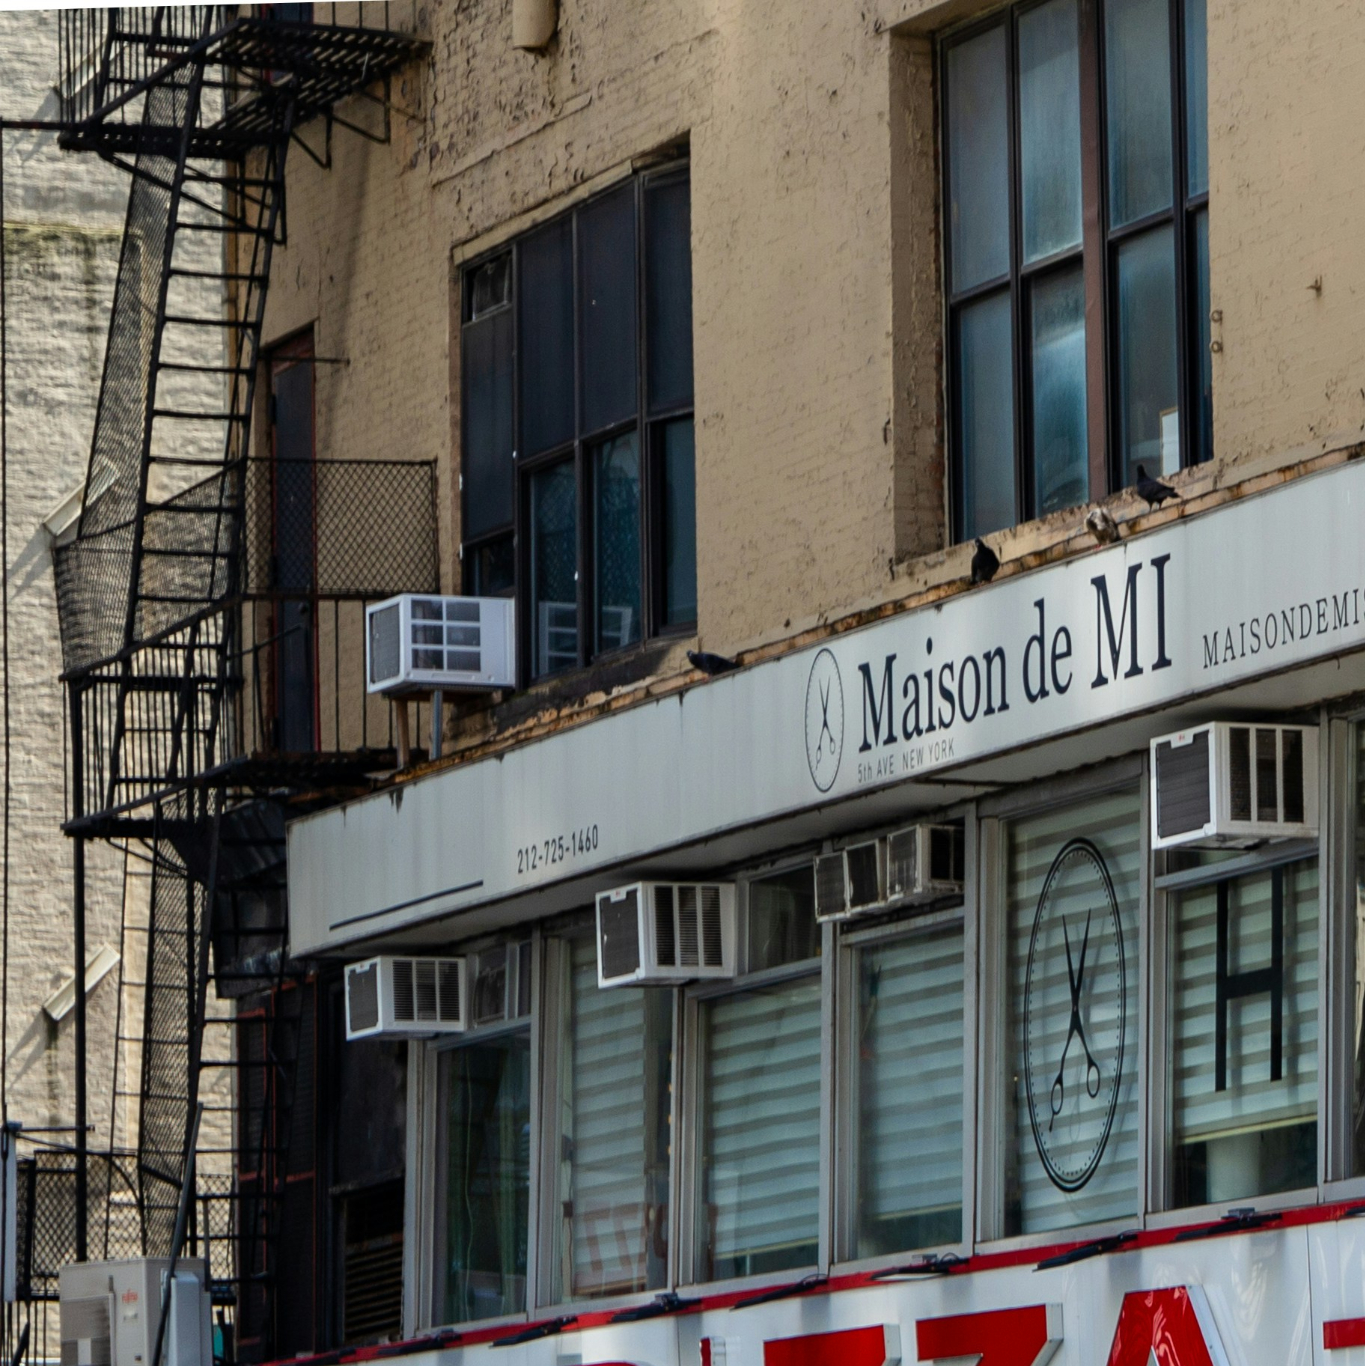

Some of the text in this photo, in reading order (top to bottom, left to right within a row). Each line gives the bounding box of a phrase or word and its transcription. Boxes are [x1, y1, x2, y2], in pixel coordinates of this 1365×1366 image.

[858, 553, 1173, 752] Maison de MI
[857, 737, 955, 783] 5th AVE NEW YORK
[516, 825, 599, 875] 212-725-1460
